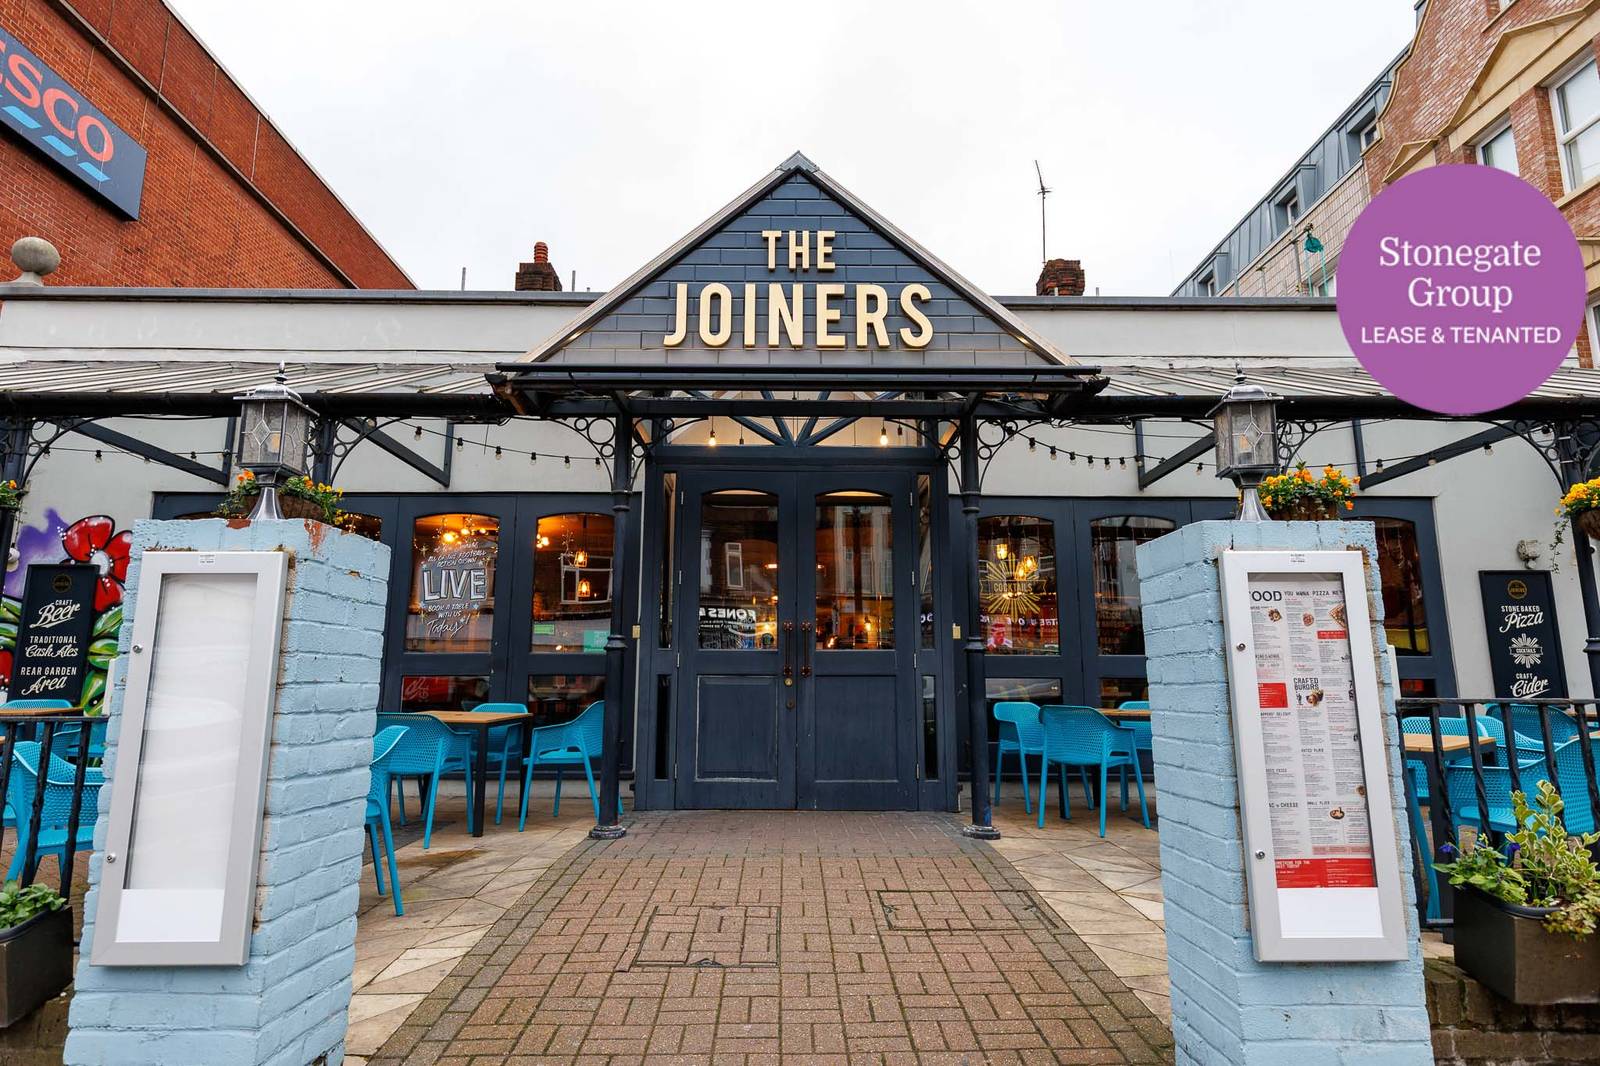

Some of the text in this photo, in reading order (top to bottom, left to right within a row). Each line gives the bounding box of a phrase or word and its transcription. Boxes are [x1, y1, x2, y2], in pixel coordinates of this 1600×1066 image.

[0, 41, 114, 162] SCO
[762, 230, 836, 271] THE
[663, 282, 934, 348] JOINERS
[423, 569, 485, 600] LIVE
[993, 583, 1033, 593] COCKTAILS
[1249, 590, 1283, 602] OOD
[29, 603, 80, 628] Beer
[1499, 612, 1544, 633] Pizza
[30, 636, 77, 644] TRADITIONAL
[51, 643, 79, 658] Ales
[20, 666, 77, 676] REAR GARDEN
[1515, 672, 1533, 680] CRAFT
[21, 675, 68, 696] Area
[1510, 676, 1551, 699] Cider
